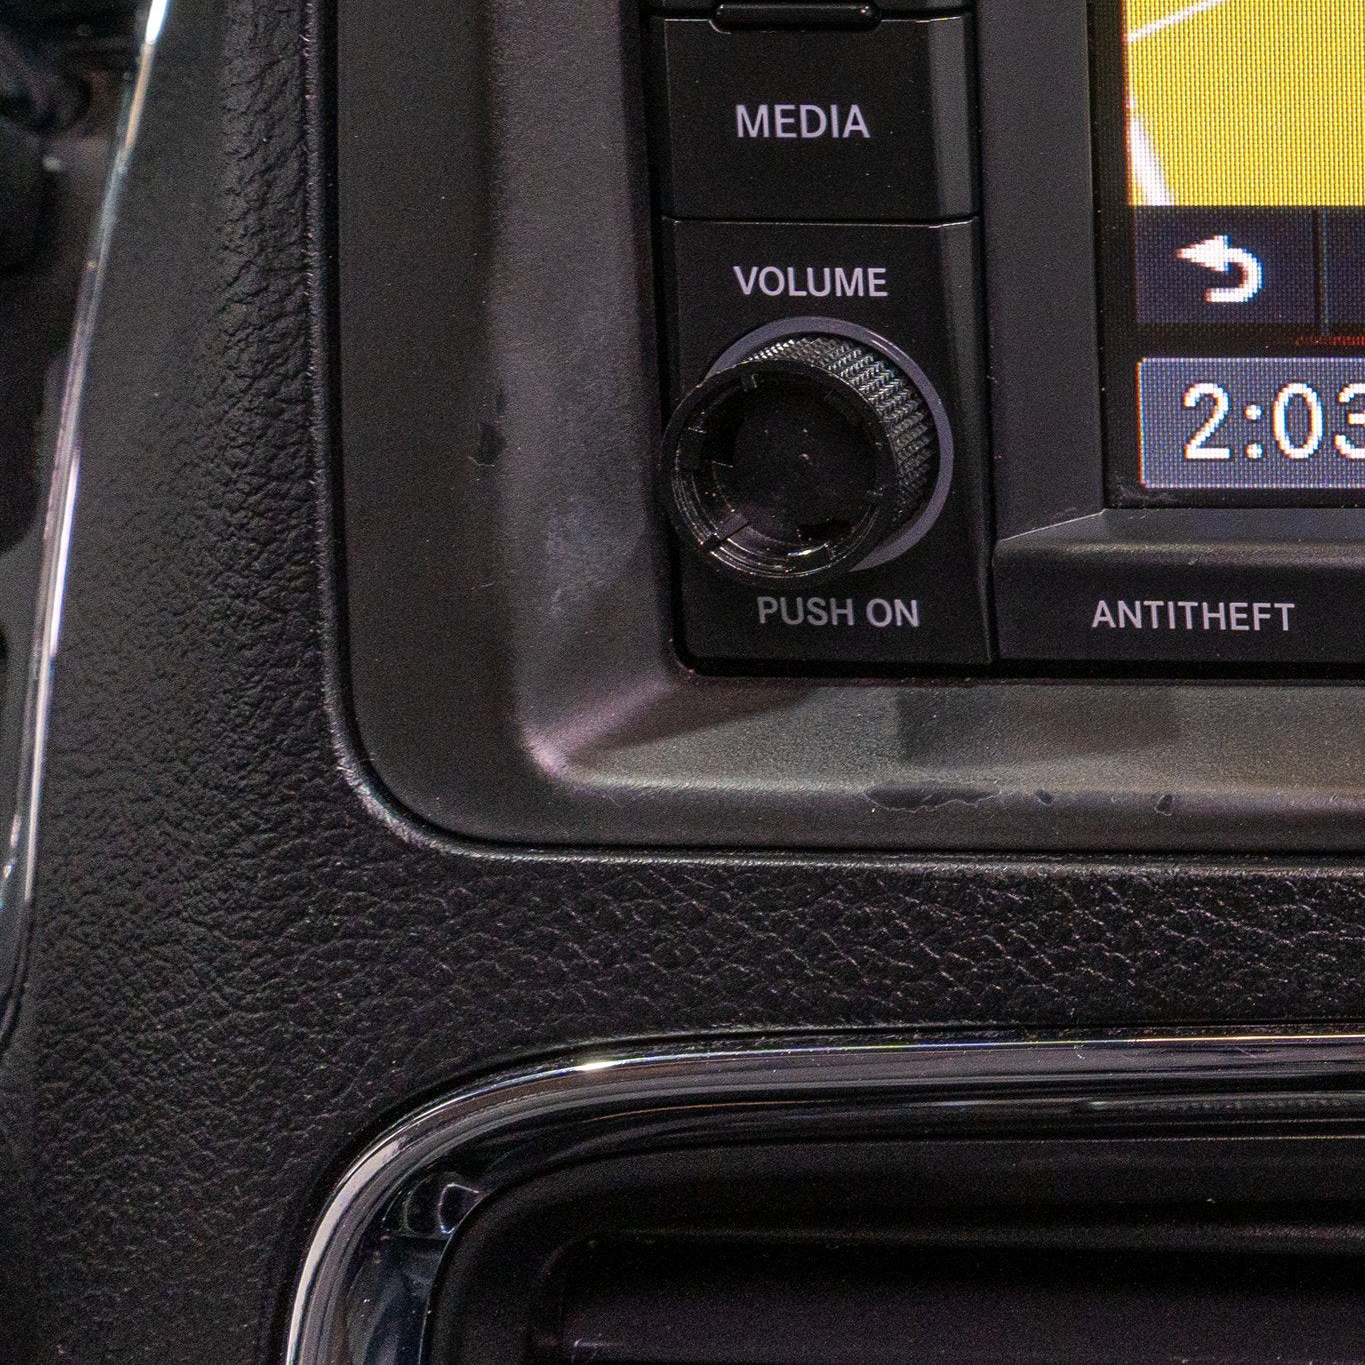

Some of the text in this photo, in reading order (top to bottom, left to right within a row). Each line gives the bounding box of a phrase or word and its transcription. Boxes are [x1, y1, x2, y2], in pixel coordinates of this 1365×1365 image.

[735, 104, 871, 139] MEDIA
[733, 265, 889, 298] VOLUME
[757, 595, 920, 628] PUSH ON
[1091, 600, 1296, 633] ANTITHEFT
